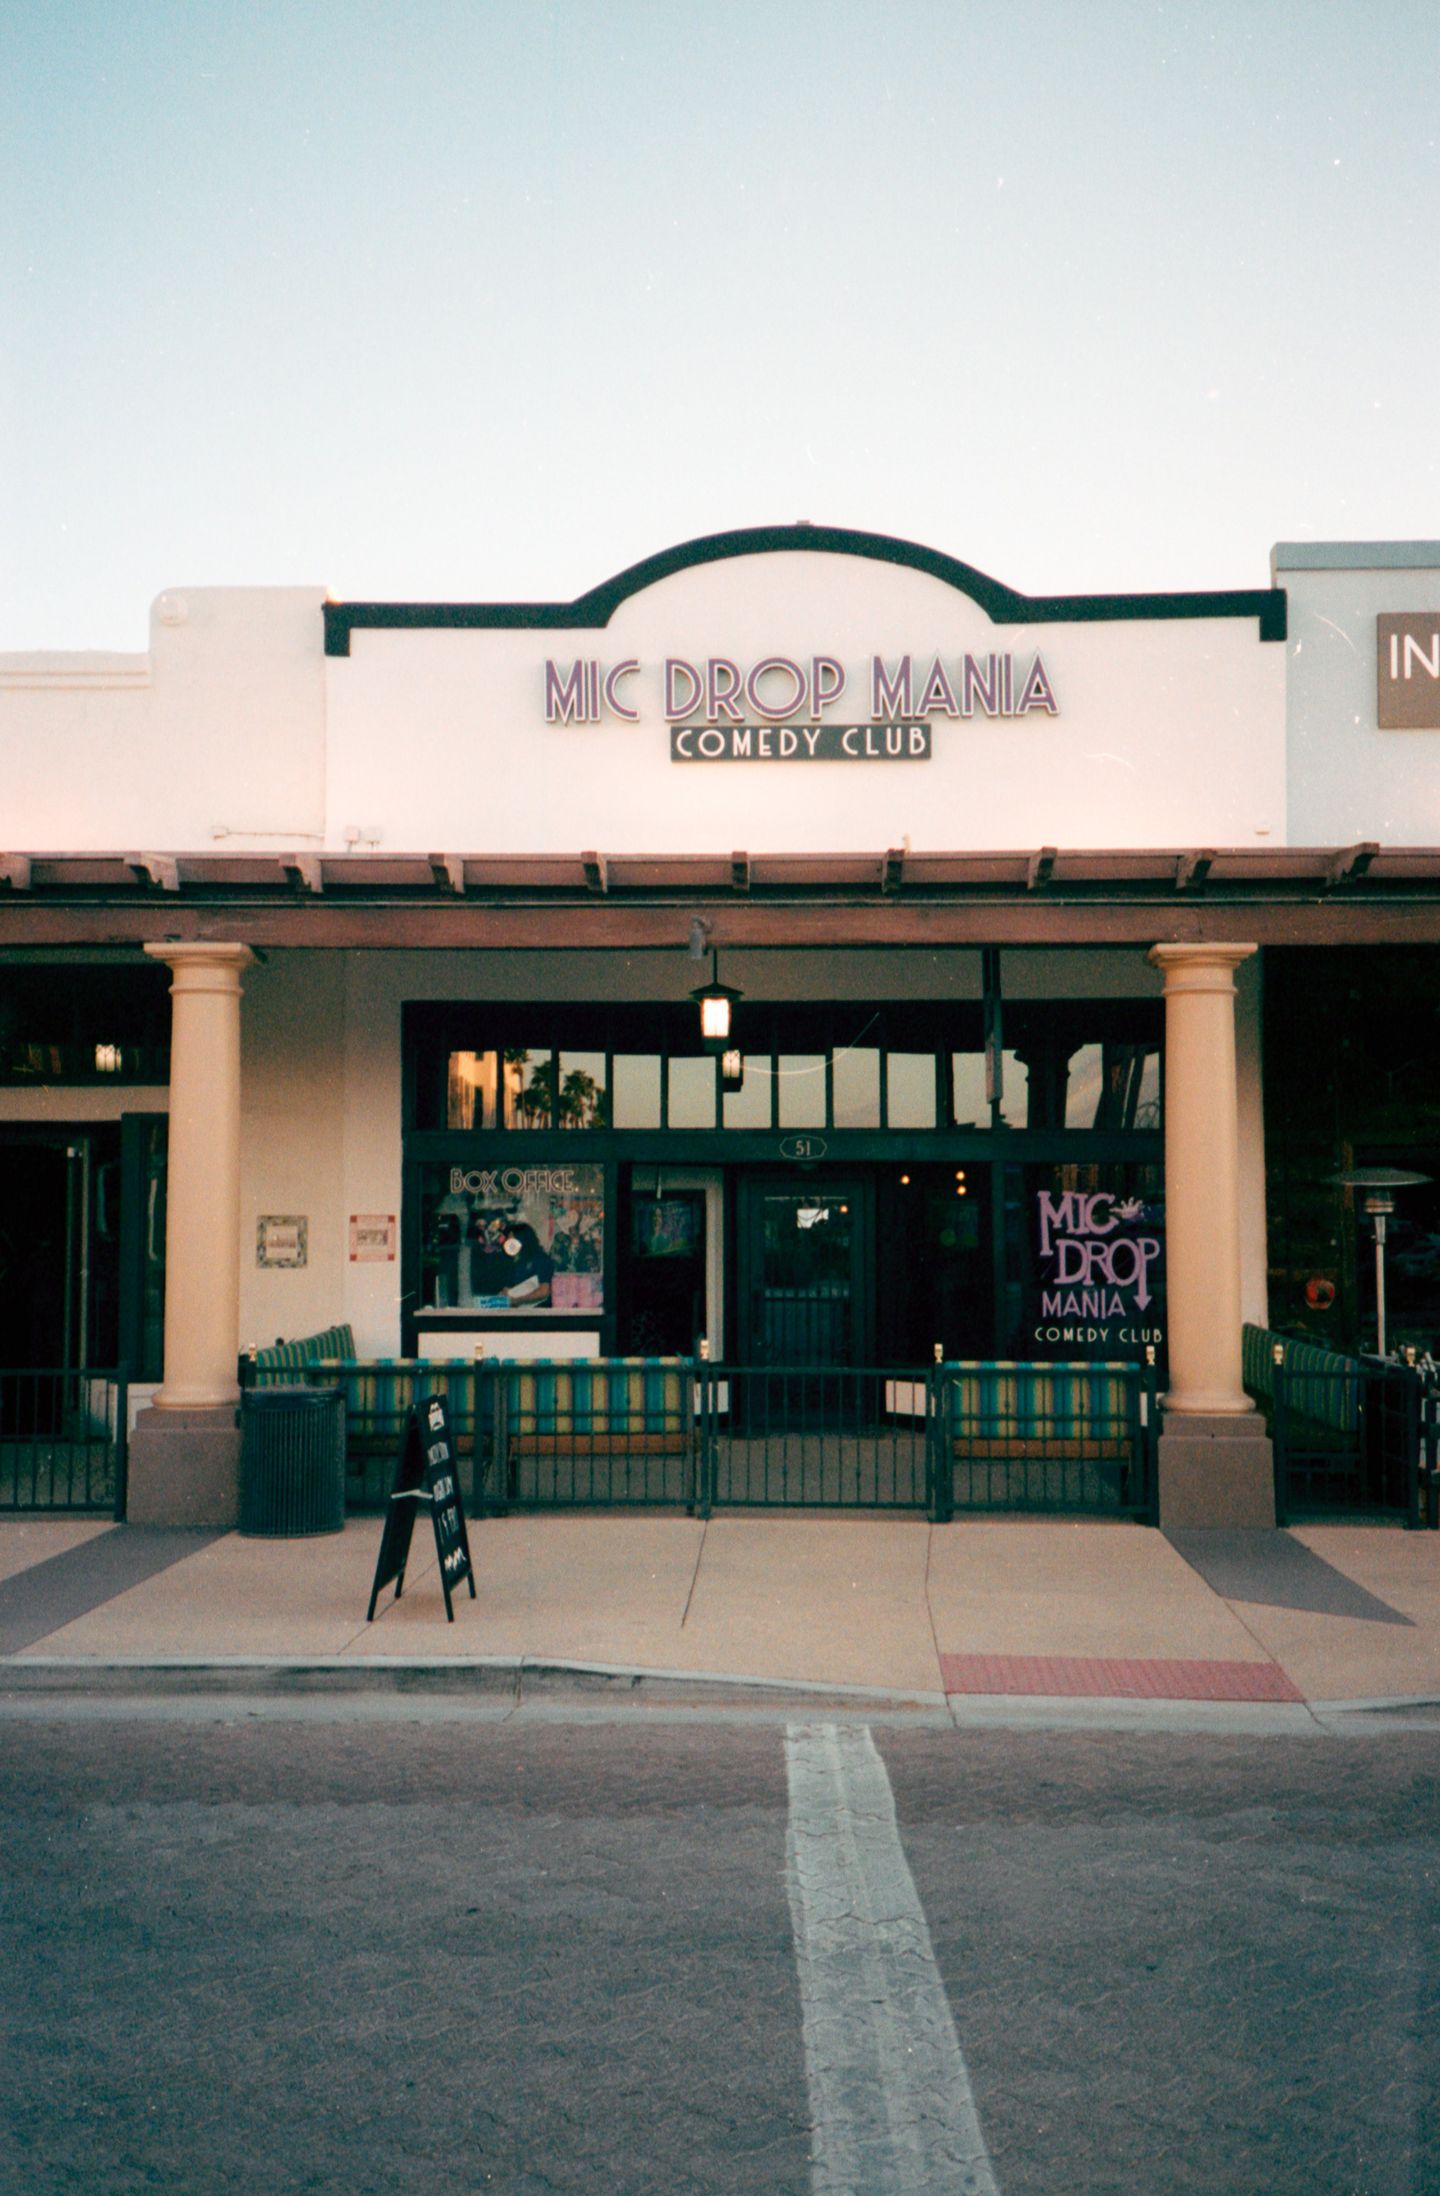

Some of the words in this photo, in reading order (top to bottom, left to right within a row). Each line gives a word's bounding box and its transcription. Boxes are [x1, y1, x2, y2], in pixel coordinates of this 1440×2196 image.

[1390, 633, 1440, 680] IN
[545, 658, 641, 723] MIC
[664, 656, 846, 722] DROP
[871, 647, 1061, 722] MANIA
[675, 728, 822, 759] COMEDY
[842, 726, 927, 757] CLUB
[795, 1140, 811, 1157] 51
[450, 1167, 499, 1194] BOX
[501, 1167, 576, 1194] OFFICE
[1036, 1190, 1120, 1257] MIC
[1053, 1237, 1161, 1312] DROP
[1041, 1288, 1127, 1320] MANIA
[1034, 1326, 1110, 1342] COMEDY
[1118, 1327, 1163, 1343] CLUB
